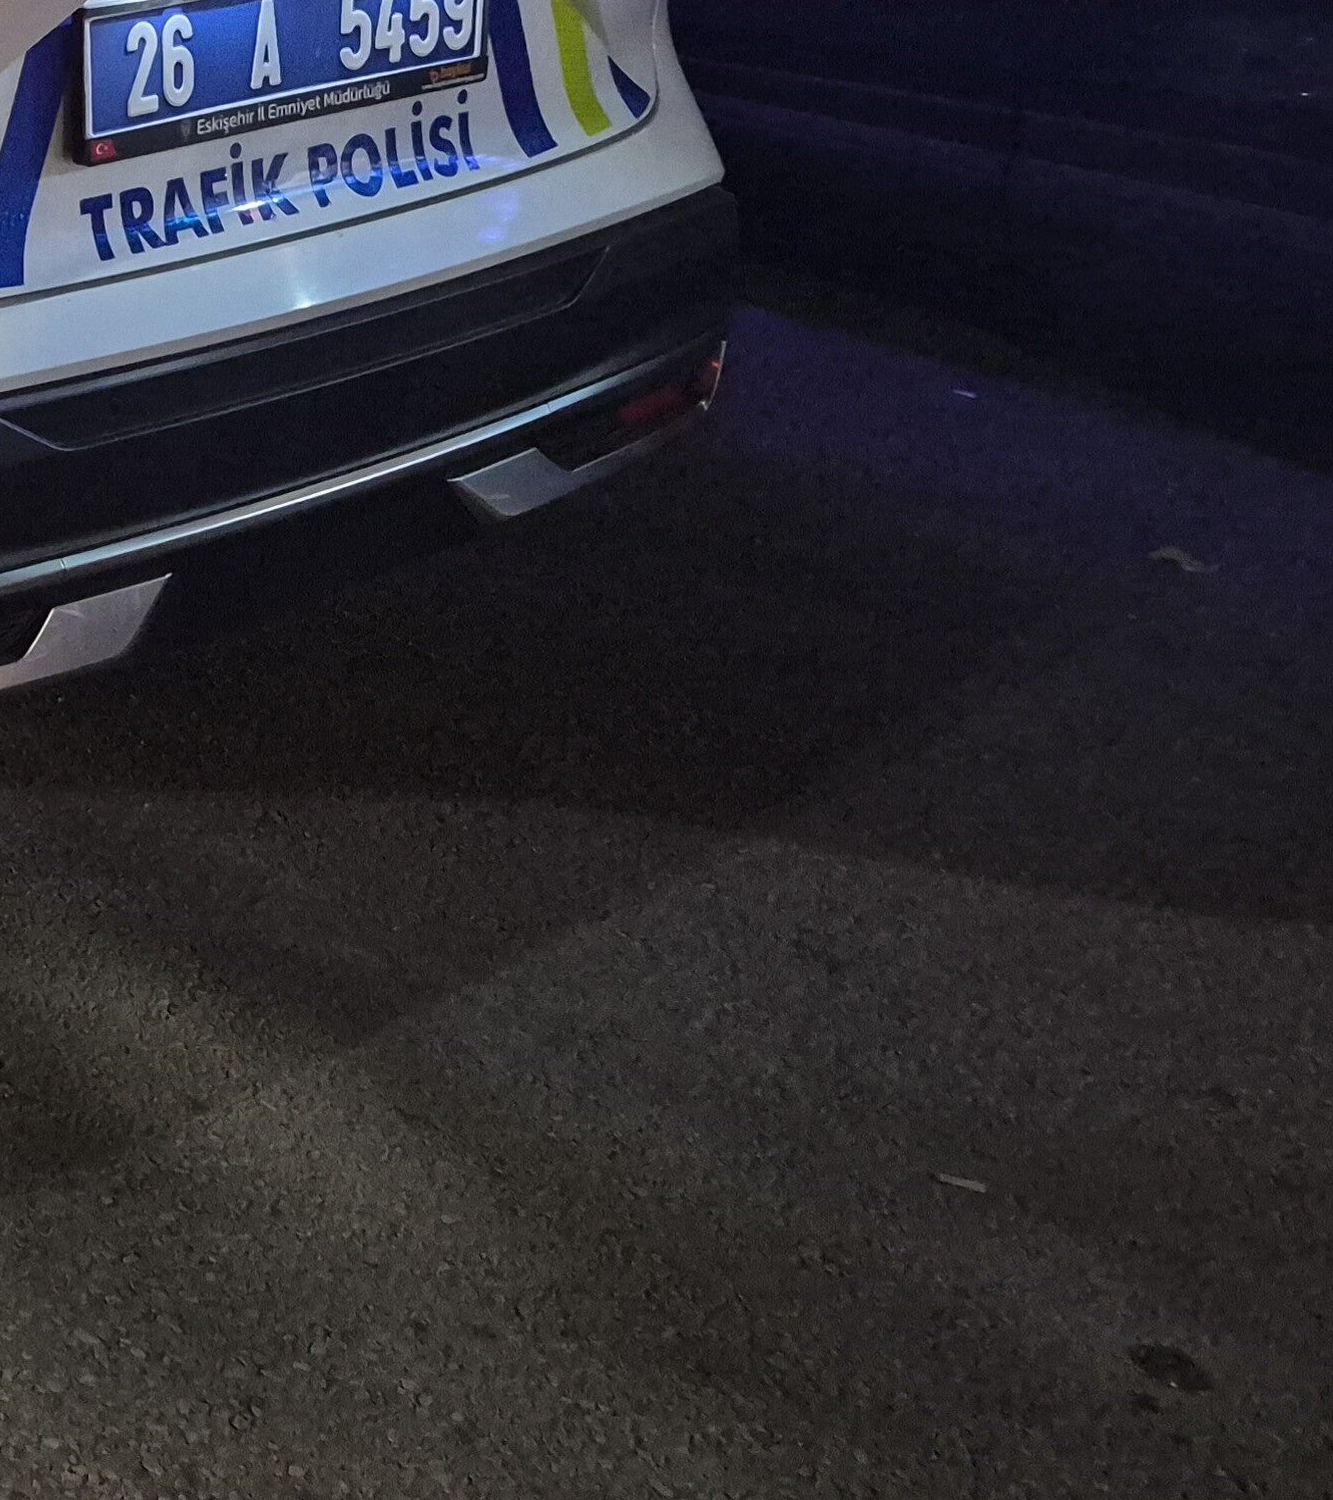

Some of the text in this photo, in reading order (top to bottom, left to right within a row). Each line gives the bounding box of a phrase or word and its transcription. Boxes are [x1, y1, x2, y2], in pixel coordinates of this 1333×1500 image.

[124, 12, 196, 119] 26
[195, 110, 256, 136] Eskişehir
[268, 96, 322, 122] Emniyet
[323, 80, 392, 110] Müdürlüğü
[79, 88, 481, 262] TRAFİK POLİSİ
